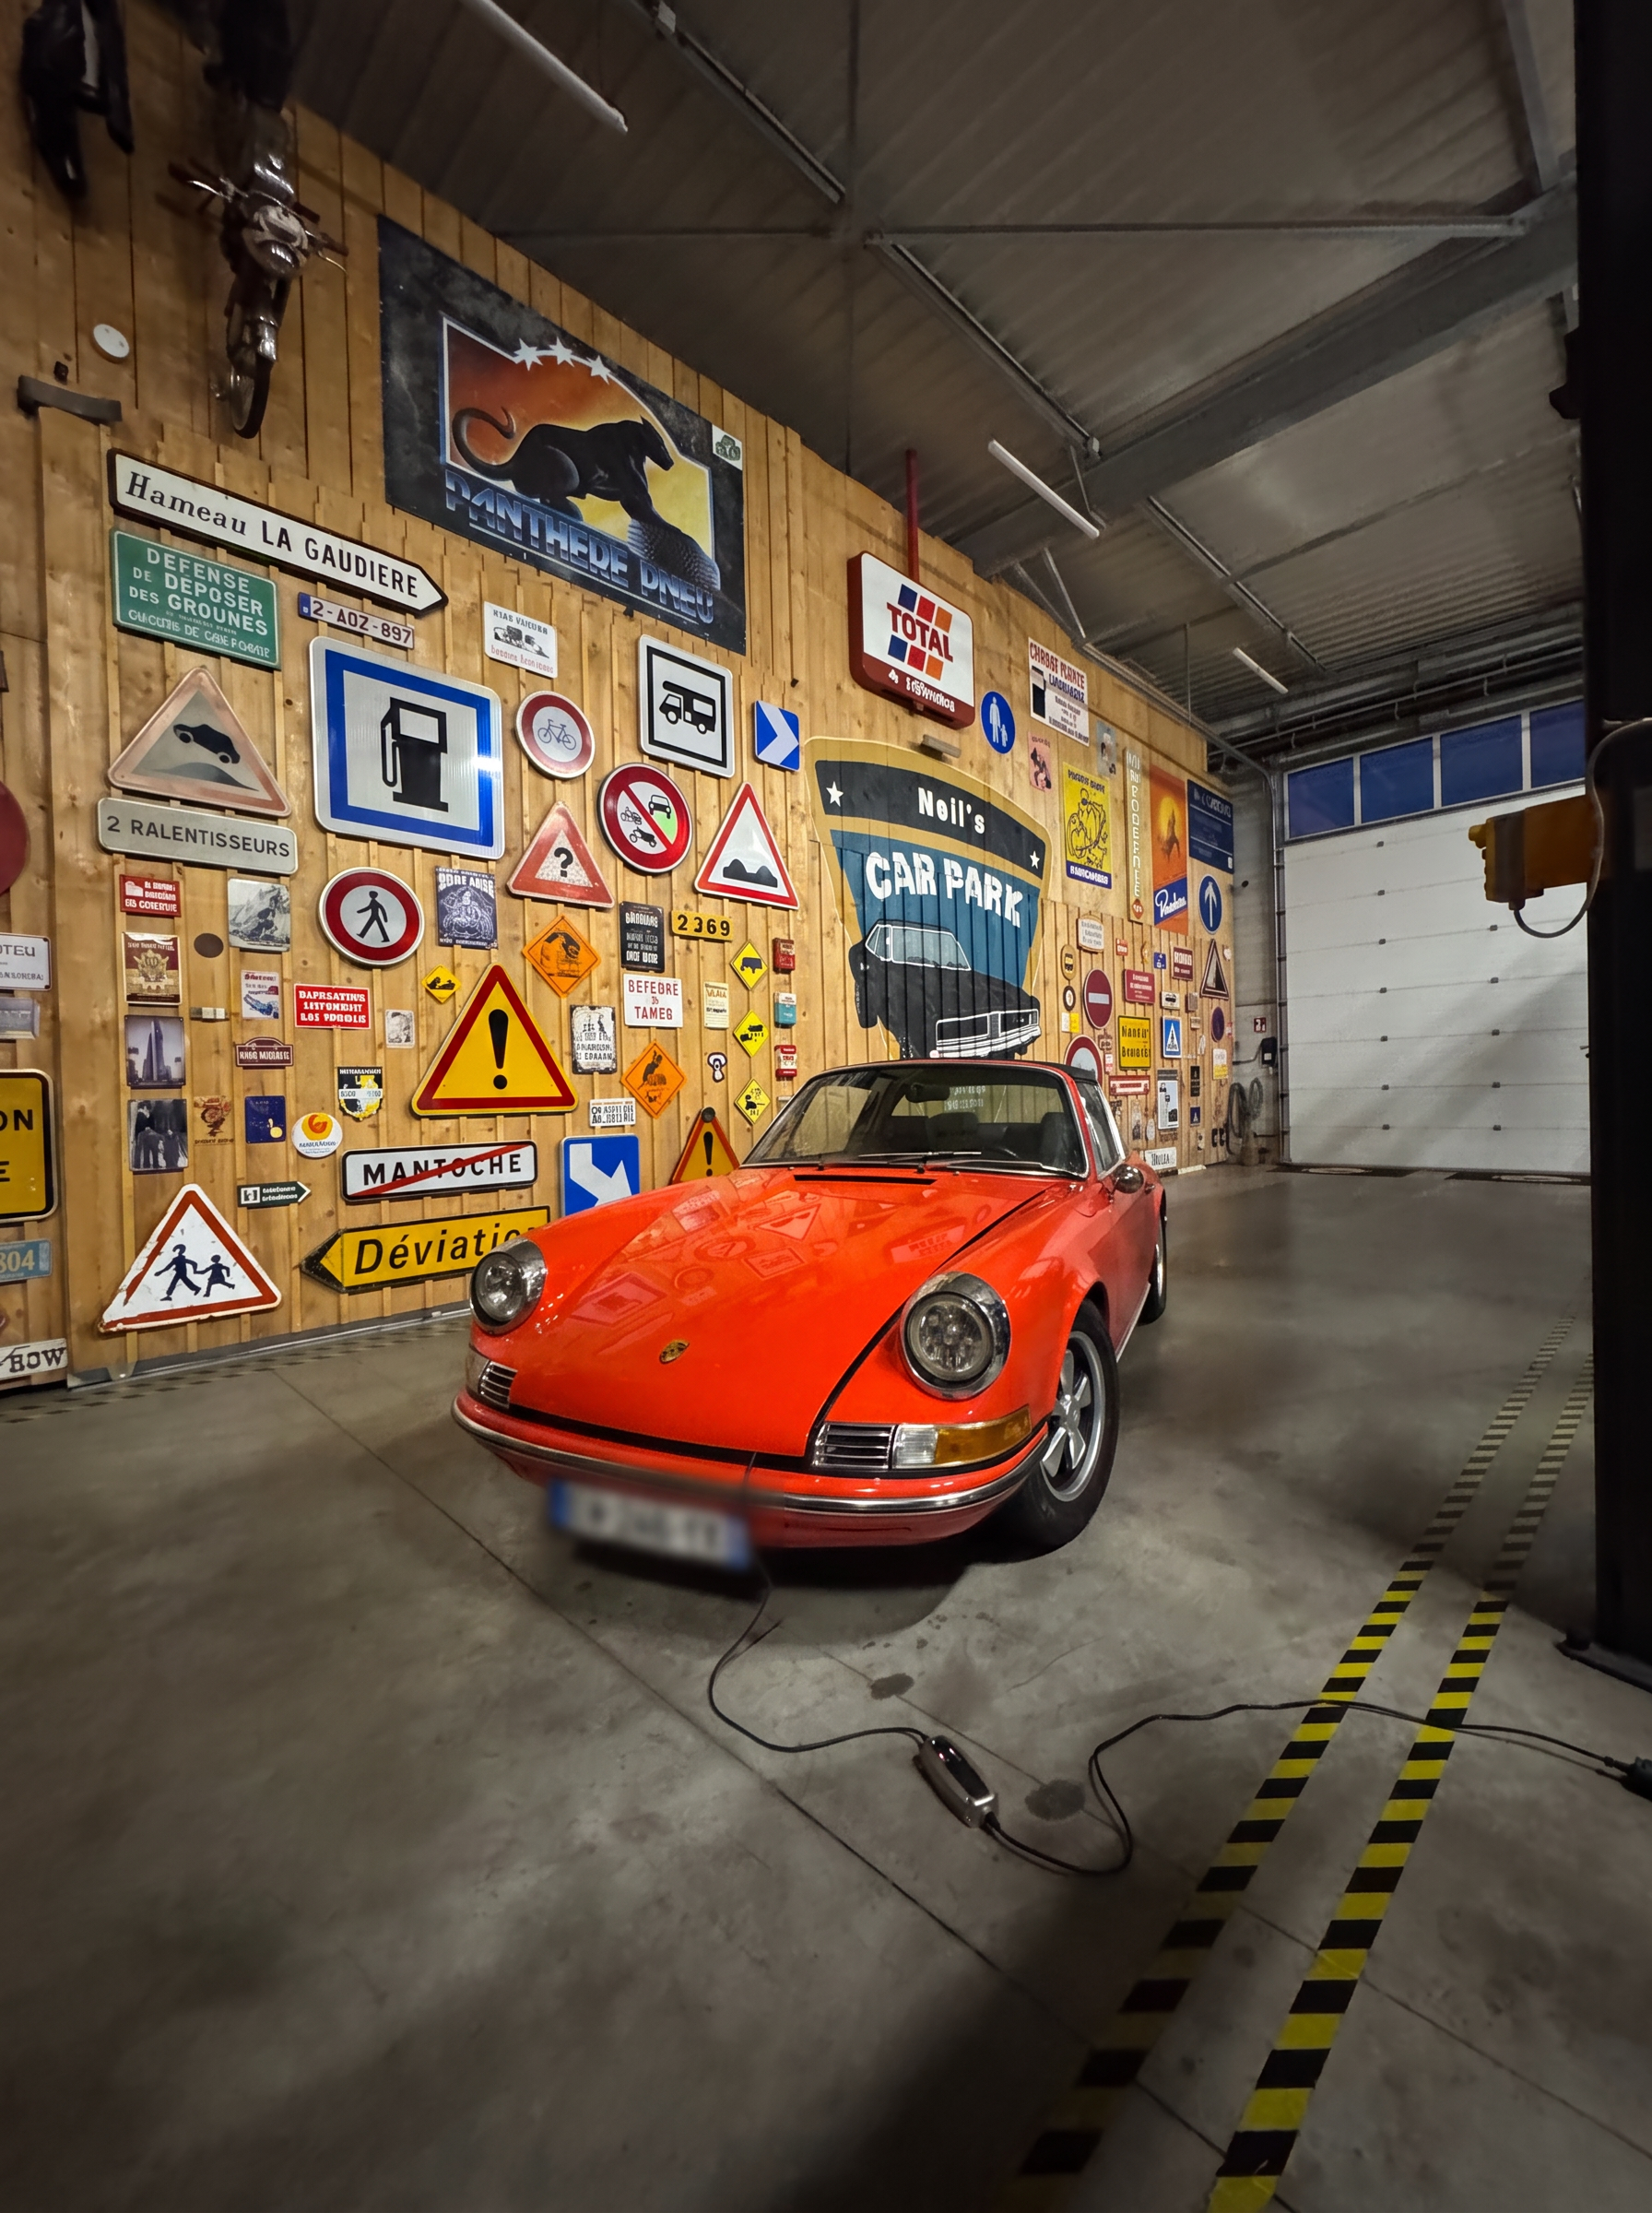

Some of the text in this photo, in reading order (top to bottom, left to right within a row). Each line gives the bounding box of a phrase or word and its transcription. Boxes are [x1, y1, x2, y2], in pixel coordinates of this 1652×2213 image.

[125, 471, 418, 598] Hameau LA GAUDIERE
[133, 566, 152, 582] DE
[147, 547, 250, 594] DEFENSE
[129, 586, 159, 604] DES
[886, 601, 953, 663] TOTAL
[918, 787, 985, 834] Neil's
[107, 815, 289, 858] 2 RALENTISSEURS
[866, 851, 1023, 929] CAR PARK
[362, 1154, 522, 1187] MANTOCHE
